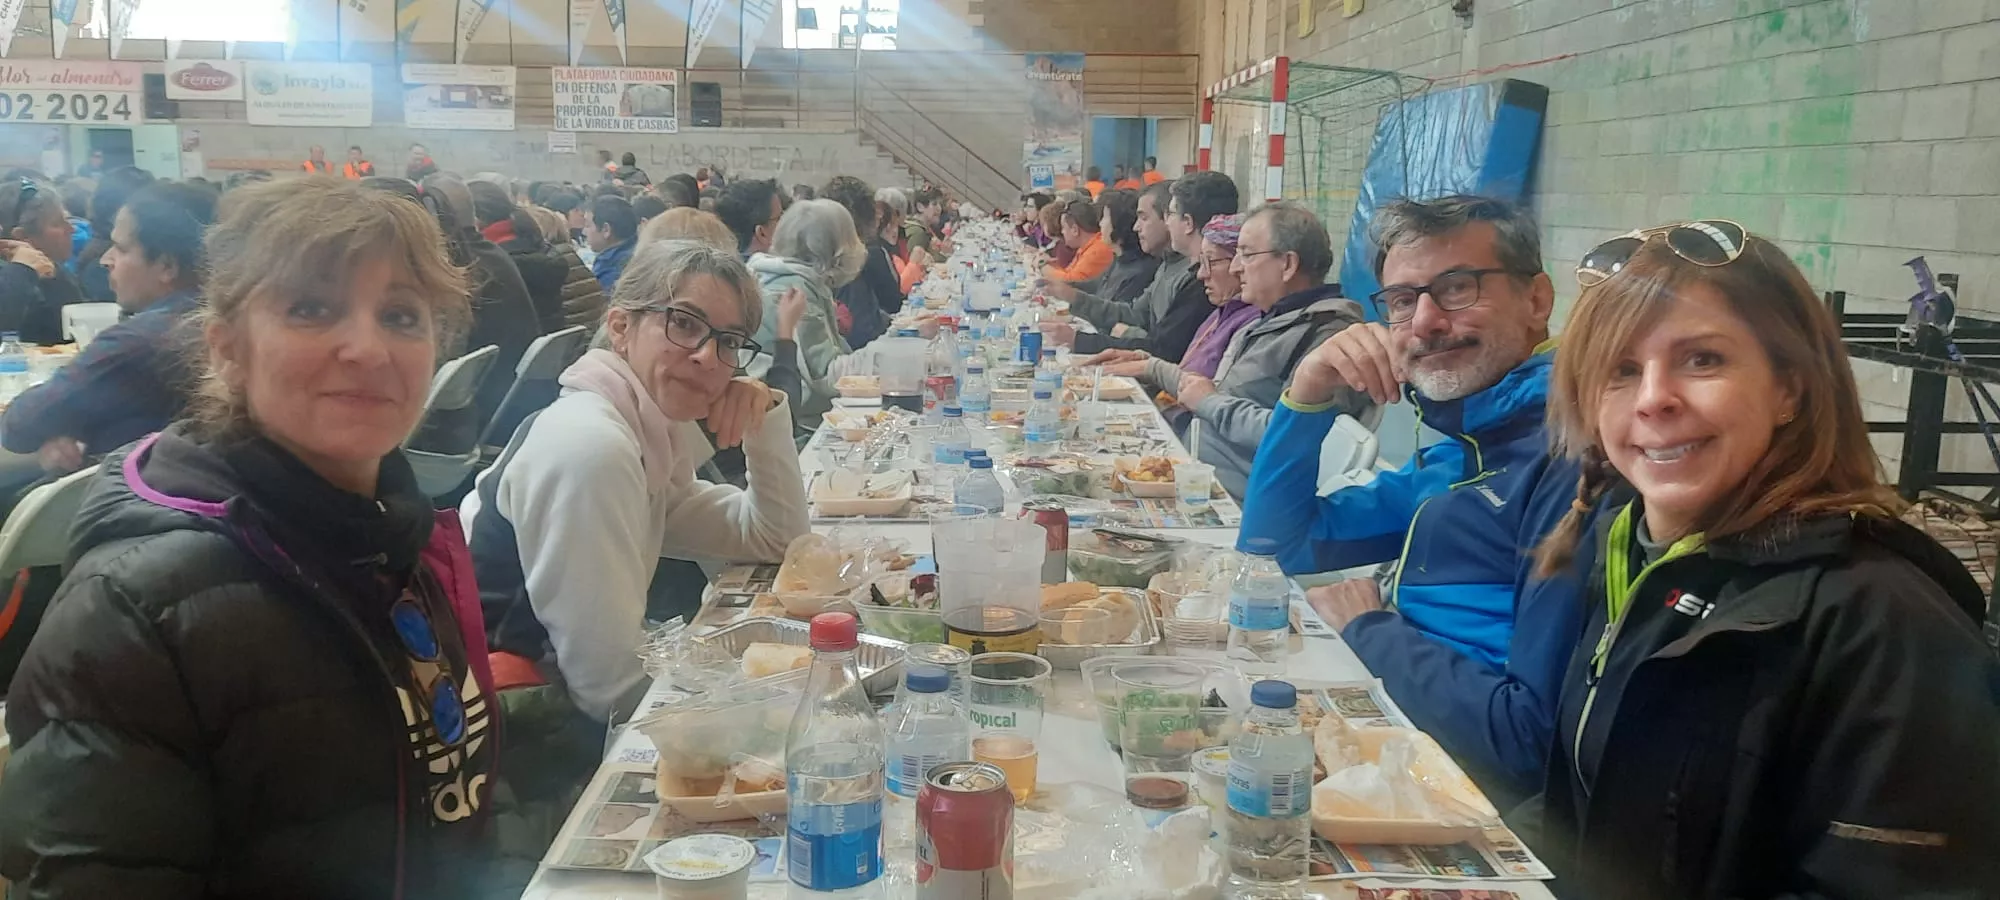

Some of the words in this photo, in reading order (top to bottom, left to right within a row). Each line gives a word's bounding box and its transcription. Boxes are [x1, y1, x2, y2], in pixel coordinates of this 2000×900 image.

[181, 72, 226, 86] Ferrer
[554, 69, 617, 81] PLATAFORMA
[620, 70, 675, 81] CIUDADANA
[555, 82, 569, 94] EN
[571, 82, 617, 94] DEFENSA
[572, 94, 585, 104] DE
[588, 95, 600, 104] LA
[556, 105, 616, 117] PROPIEDAD
[556, 119, 569, 129] DE
[571, 119, 583, 129] LA
[585, 119, 620, 129] VIRGEN
[623, 120, 635, 130] DE
[637, 120, 676, 131] CASBAS
